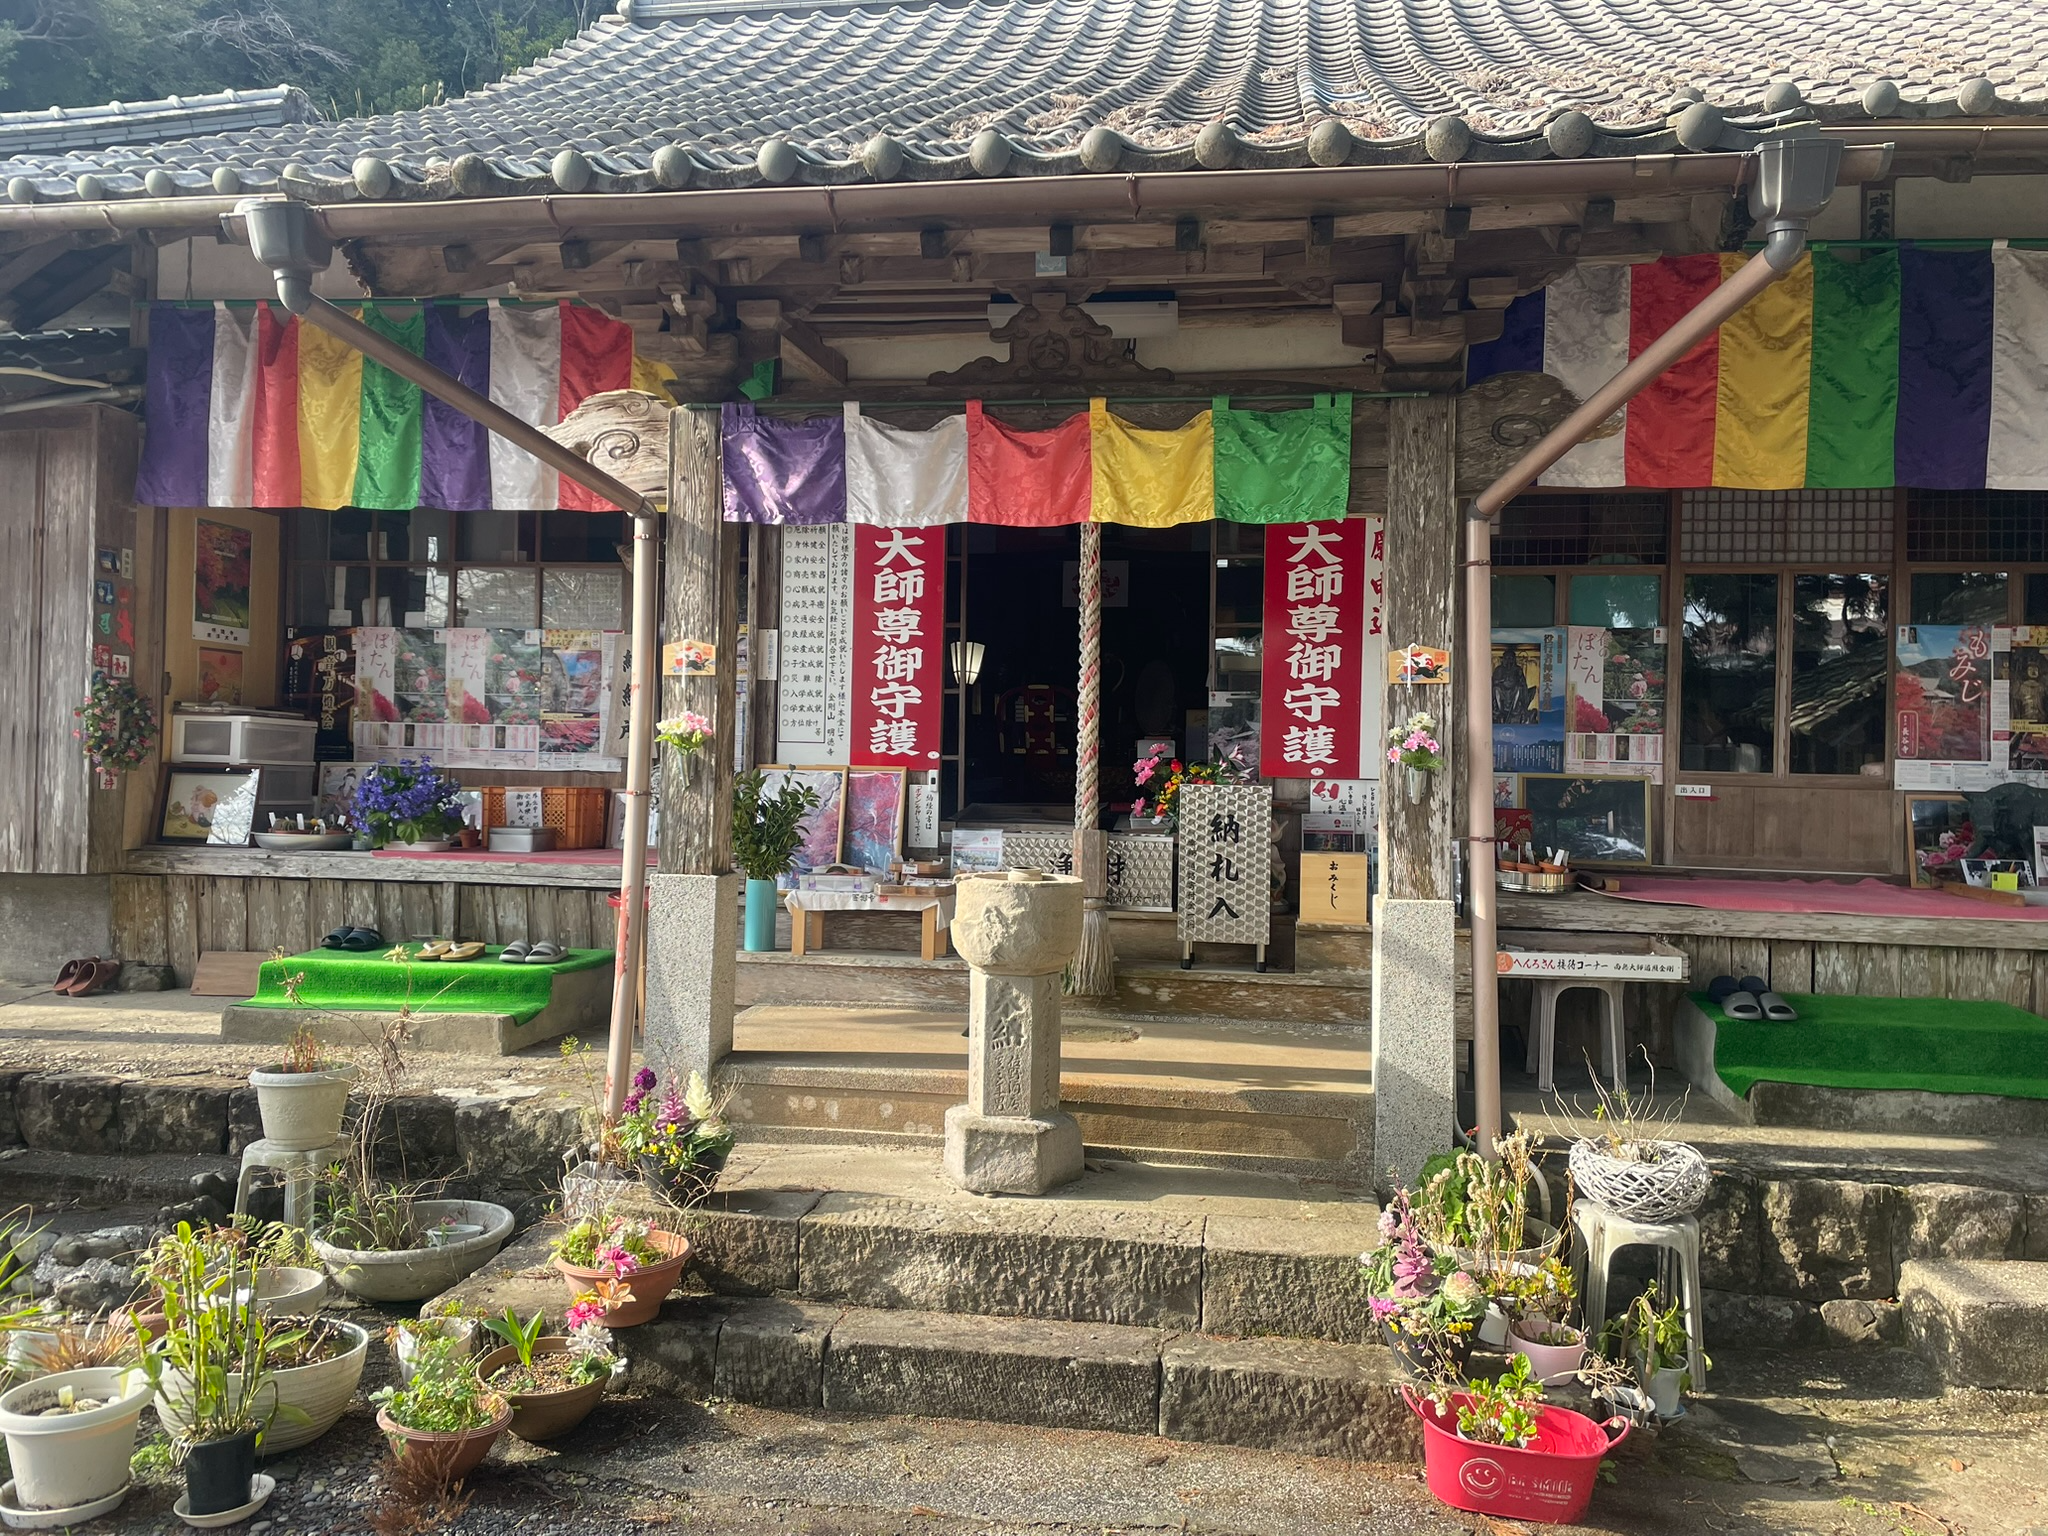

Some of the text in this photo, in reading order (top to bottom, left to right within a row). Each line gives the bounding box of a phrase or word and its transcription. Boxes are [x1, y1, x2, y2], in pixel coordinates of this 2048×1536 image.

[794, 555, 826, 564] 家内安全
[792, 615, 825, 623] 交通安全
[791, 645, 824, 653] 安産成就
[370, 633, 393, 679] ぼたん
[461, 634, 483, 680] ぼたん
[1573, 632, 1601, 684] ぼたん
[791, 659, 824, 668] 子宝成就
[1949, 630, 1987, 703] もみじ
[790, 689, 823, 698] 入学成就
[790, 704, 823, 712] 学業成就
[1680, 786, 1705, 794] 出入口
[1207, 813, 1240, 919] 納札入
[1328, 861, 1339, 910] おみくじ
